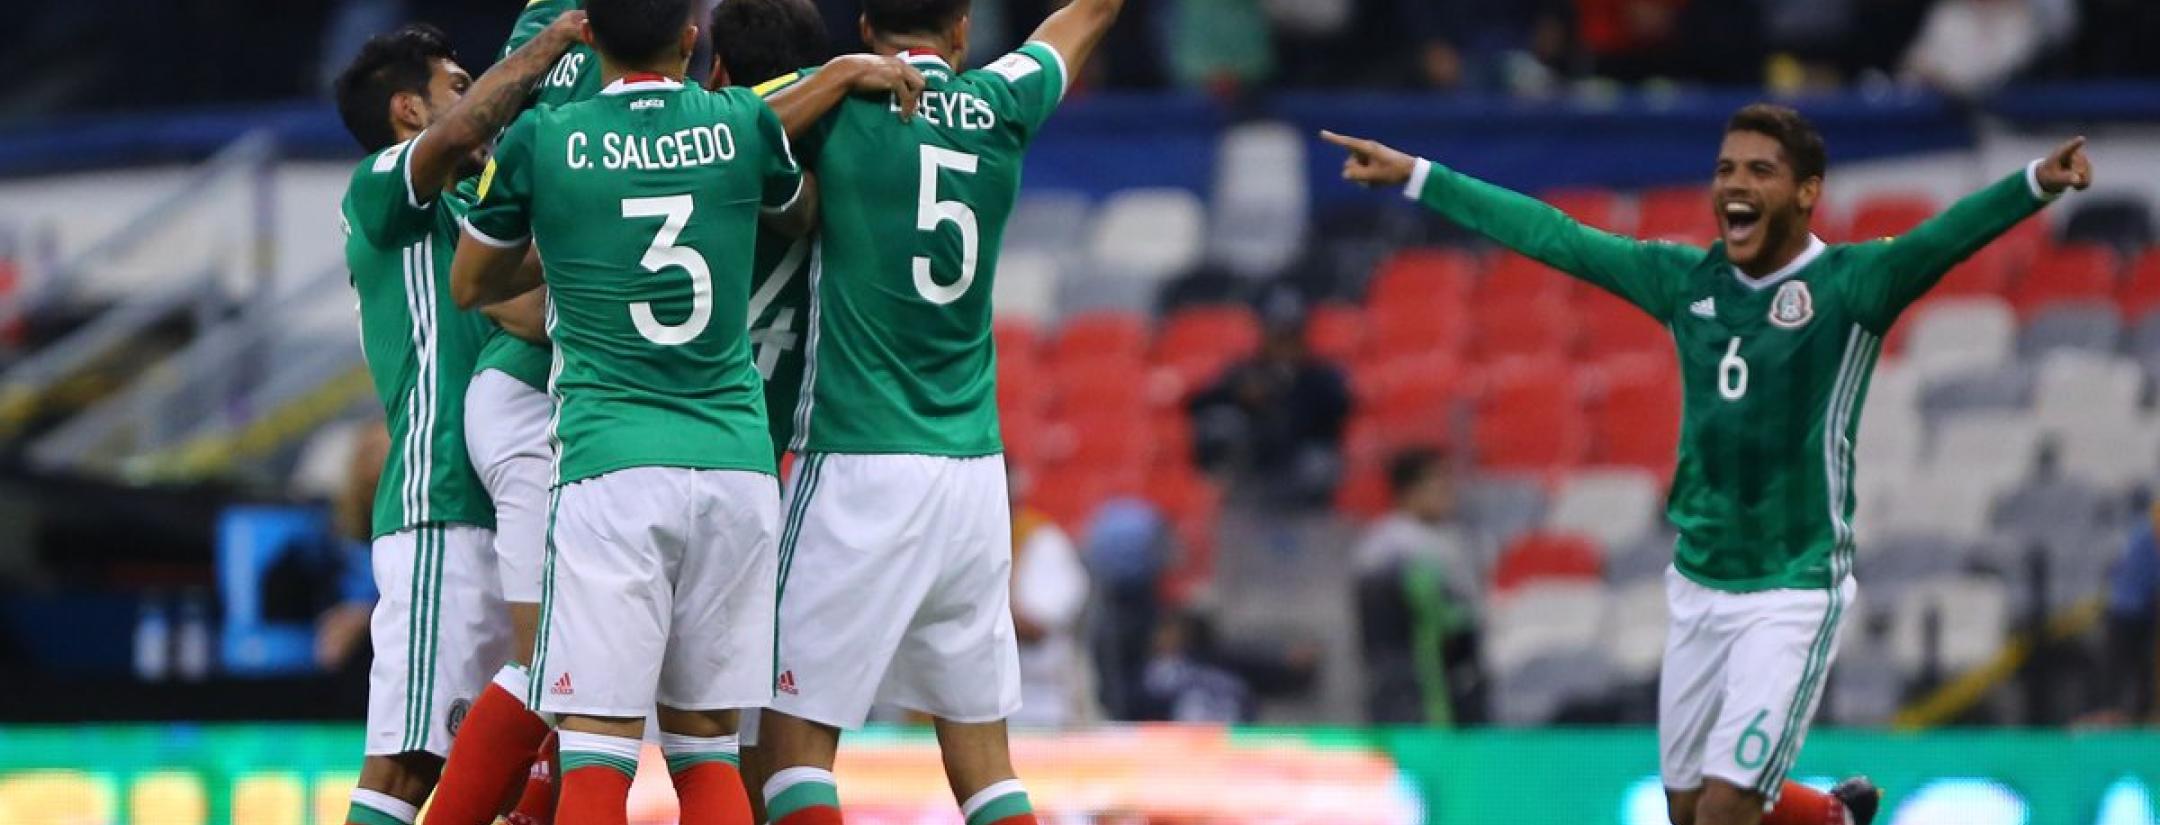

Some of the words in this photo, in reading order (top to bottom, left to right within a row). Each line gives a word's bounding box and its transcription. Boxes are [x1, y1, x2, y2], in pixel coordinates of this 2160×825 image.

[567, 131, 594, 169] C.
[602, 122, 736, 170] SALCEDO
[912, 144, 979, 305] 5
[621, 194, 713, 346] 3
[1718, 336, 1749, 400] 6
[1734, 709, 1771, 769] 6
